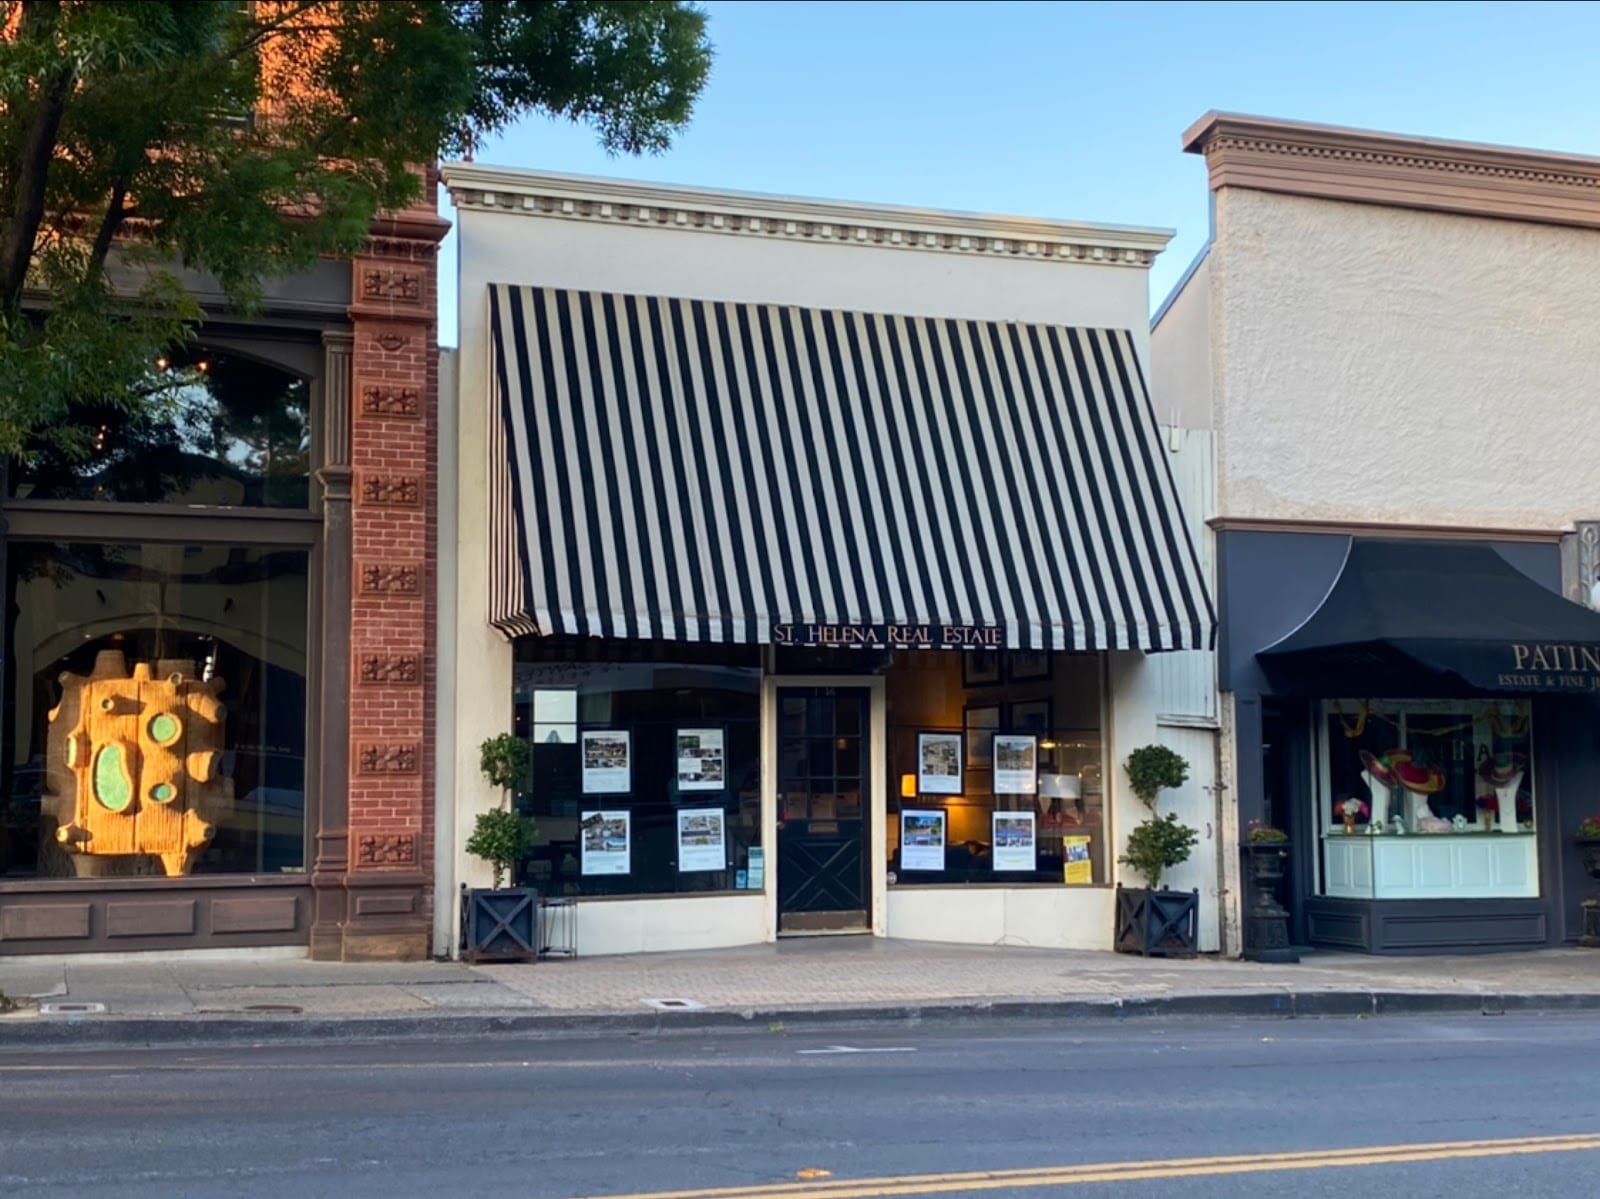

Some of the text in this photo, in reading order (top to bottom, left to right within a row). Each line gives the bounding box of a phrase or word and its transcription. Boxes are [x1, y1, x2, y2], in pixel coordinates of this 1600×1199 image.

[774, 624, 1002, 644] ST. HELENA REAL ESTATE
[1498, 674, 1540, 686] ESTATE
[1546, 676, 1555, 686] &
